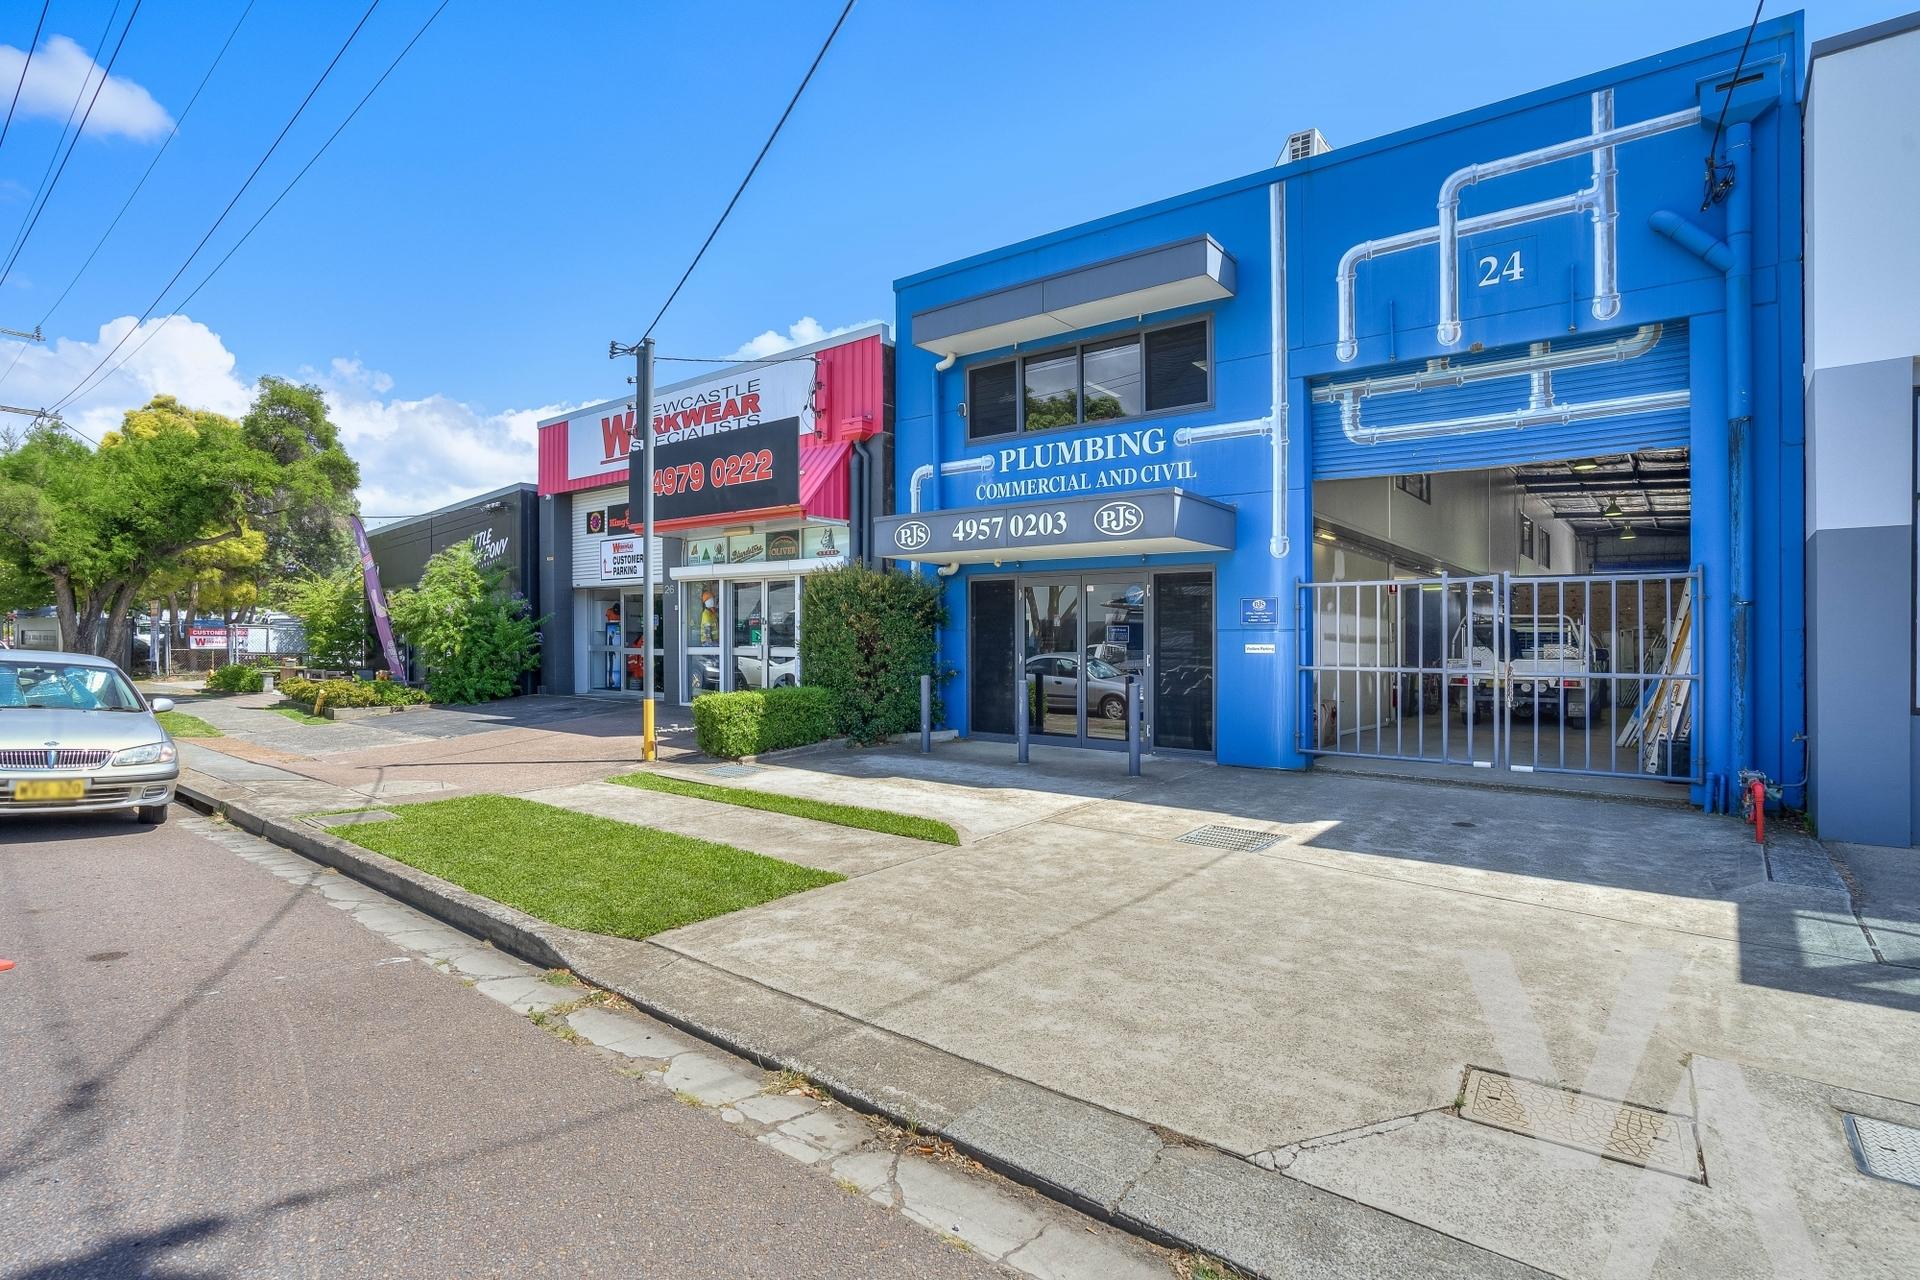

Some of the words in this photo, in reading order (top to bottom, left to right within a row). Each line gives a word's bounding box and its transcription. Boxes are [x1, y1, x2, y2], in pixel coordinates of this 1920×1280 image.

[1478, 250, 1525, 288] 24
[653, 378, 761, 417] EWCASTLE
[631, 414, 761, 452] SECIALISTS
[998, 427, 1167, 474] PLUMBING
[653, 461, 705, 497] 4979
[710, 448, 773, 489] 0222
[975, 474, 1092, 501] COMMERCIAL
[1096, 468, 1138, 488] AND
[1139, 460, 1198, 483] CIVIL
[952, 516, 1004, 542] 4957
[1009, 511, 1067, 538] 0203
[1101, 505, 1137, 531] PJS
[899, 525, 927, 546] PJS
[612, 554, 644, 566] CUSTOMER
[612, 565, 638, 576] PARKING
[664, 585, 675, 594] 26
